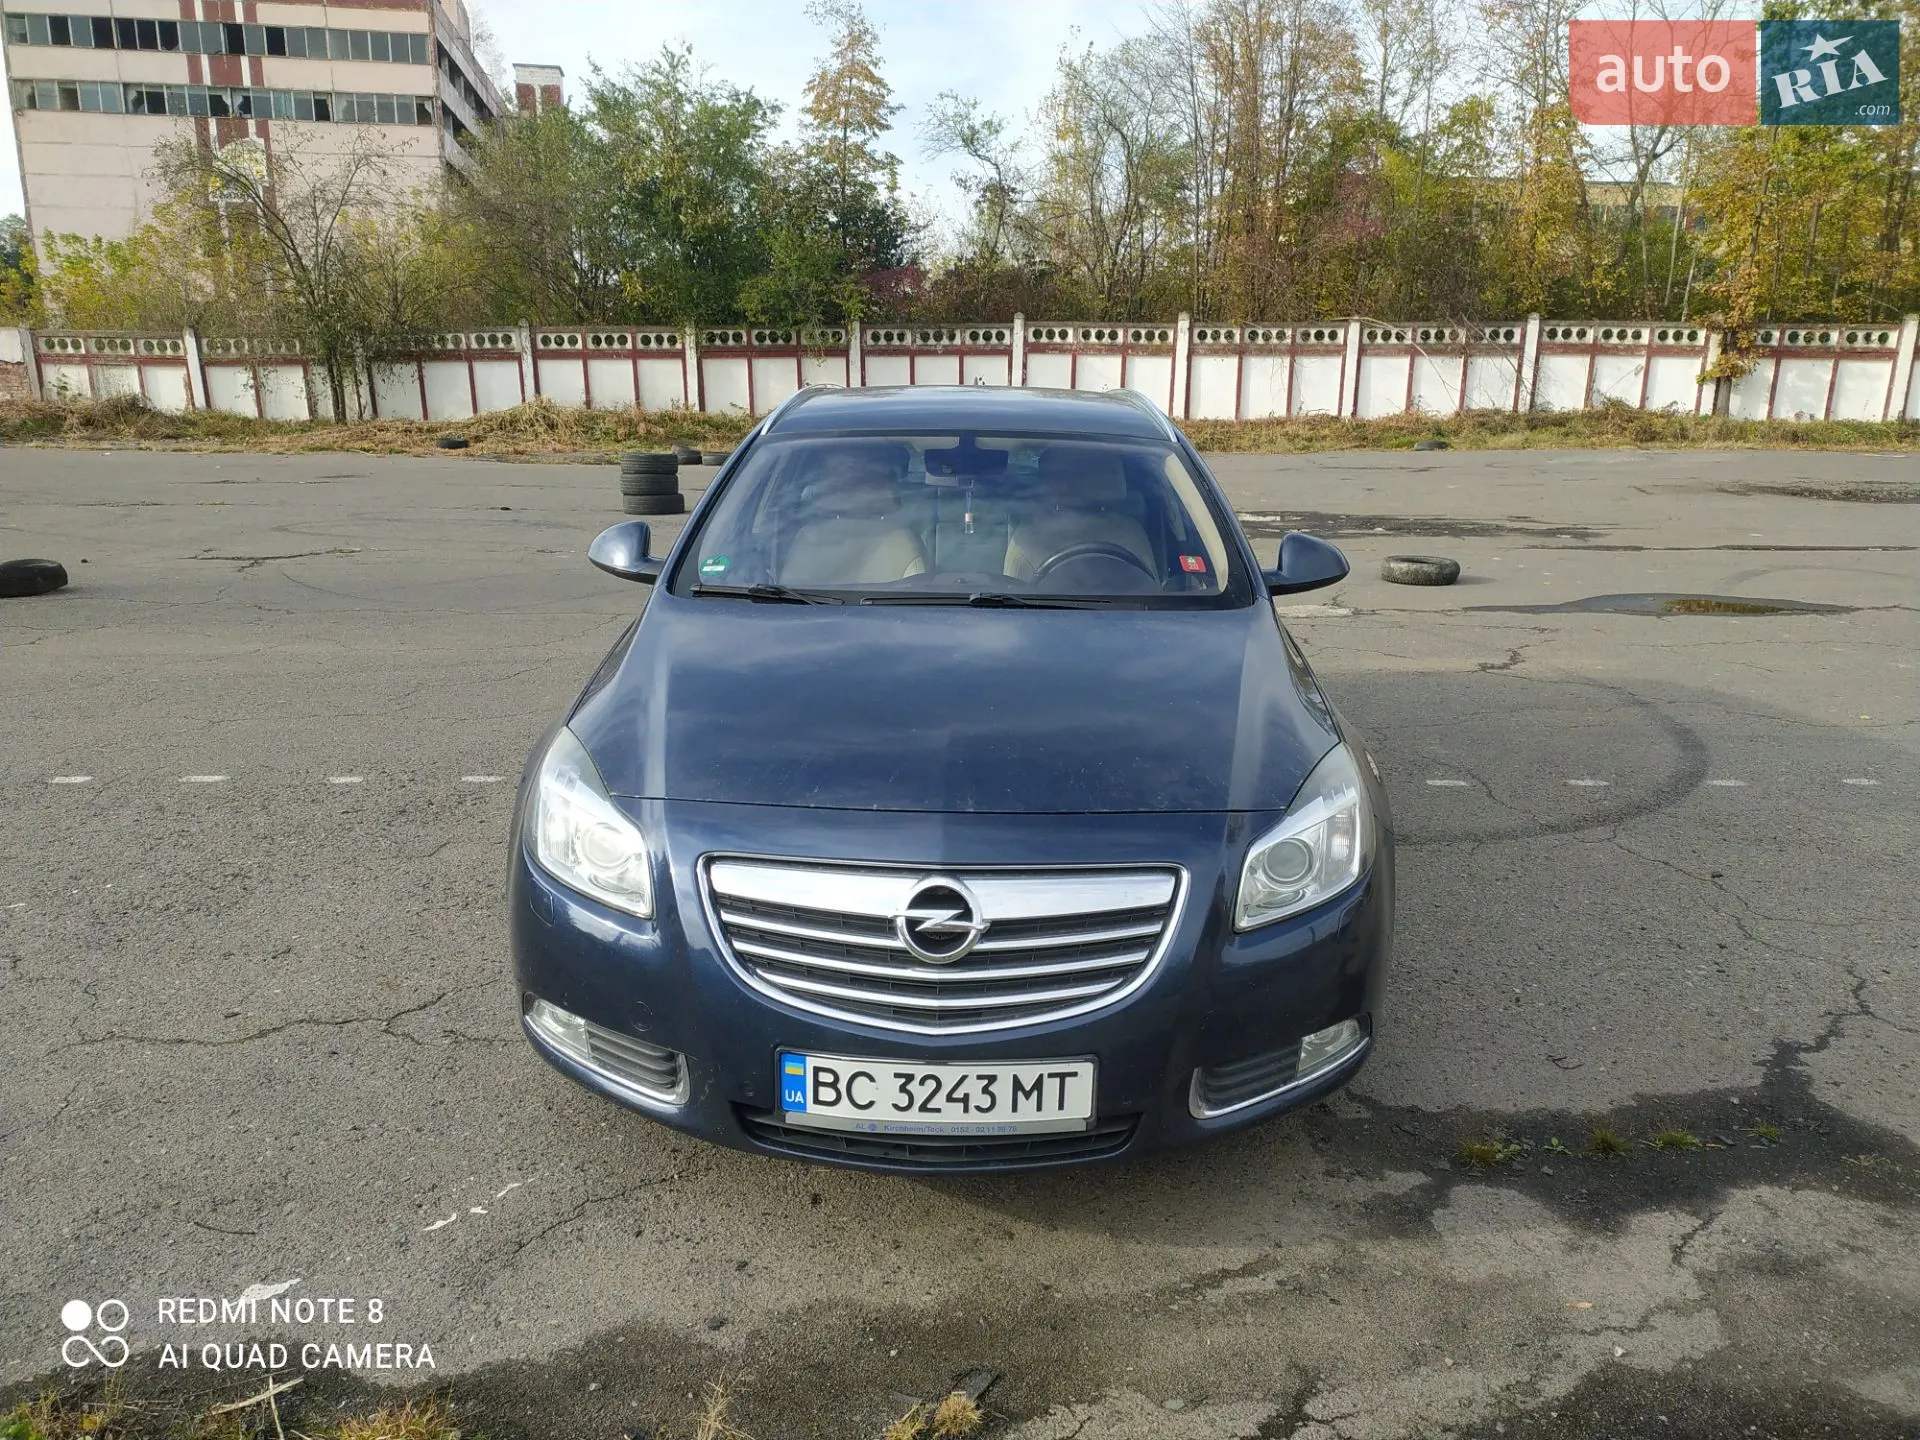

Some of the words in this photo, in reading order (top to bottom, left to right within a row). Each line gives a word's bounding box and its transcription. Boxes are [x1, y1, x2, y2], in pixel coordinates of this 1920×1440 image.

[785, 1090, 804, 1104] UA
[812, 1066, 877, 1110] BC
[891, 1073, 998, 1114] 3243
[1011, 1072, 1079, 1113] MT
